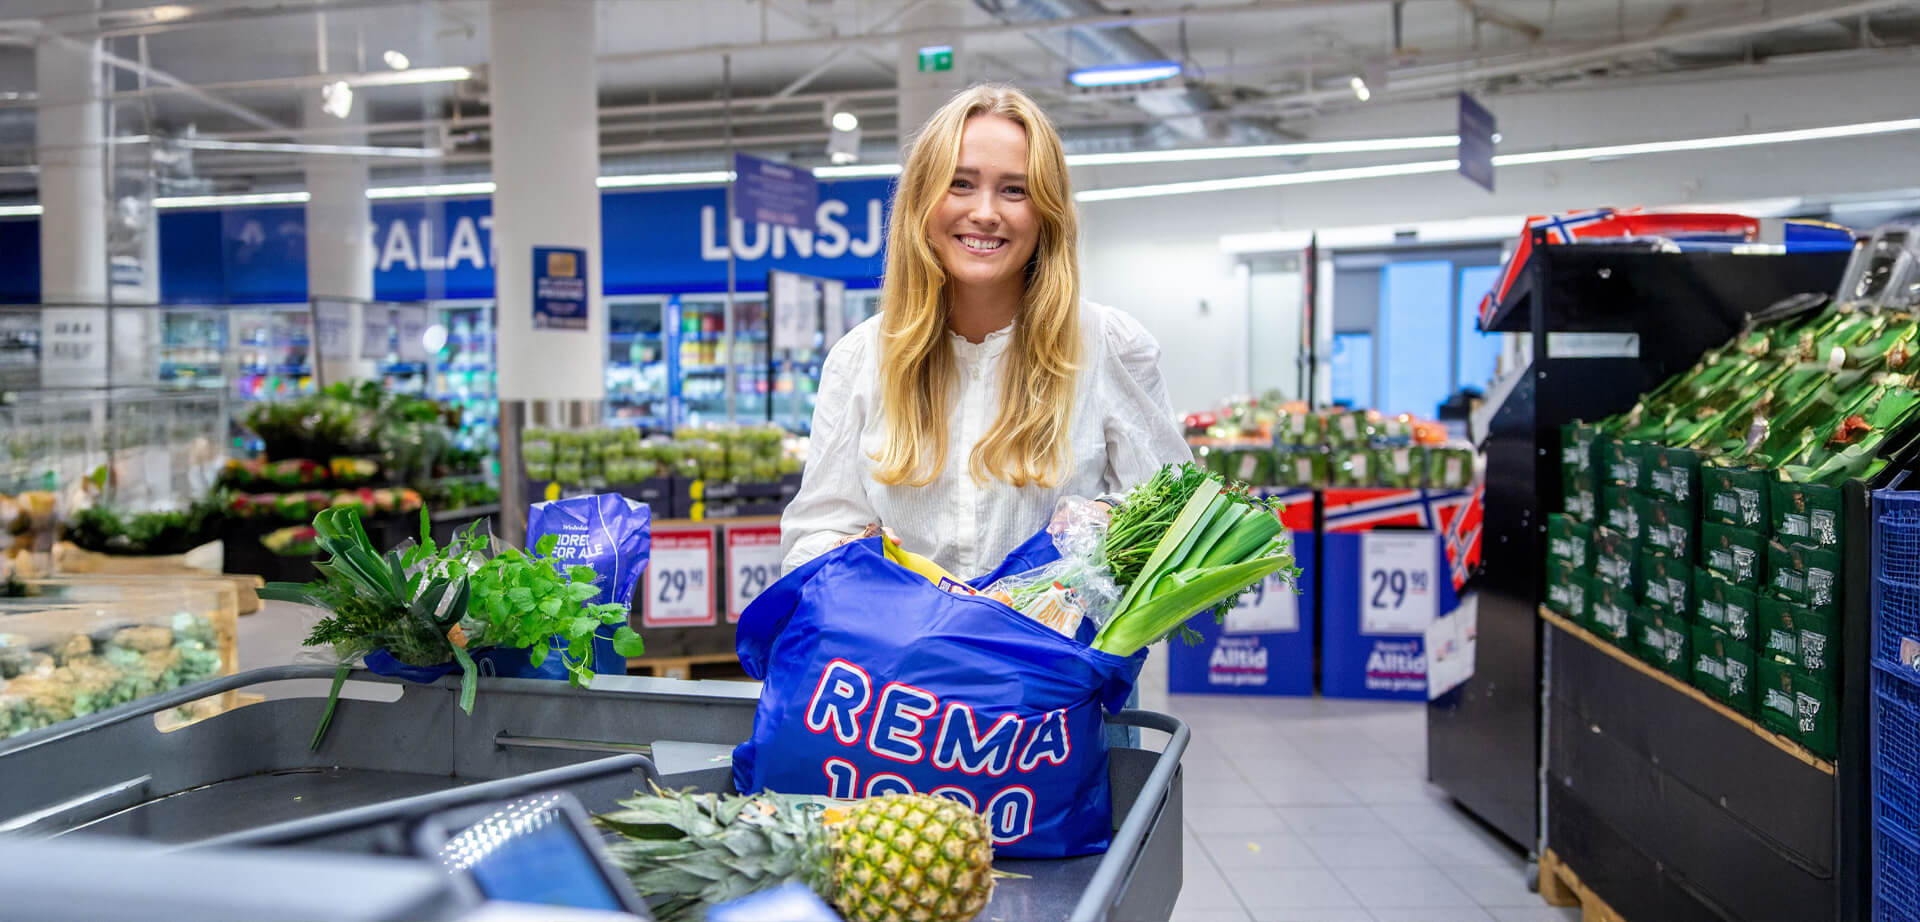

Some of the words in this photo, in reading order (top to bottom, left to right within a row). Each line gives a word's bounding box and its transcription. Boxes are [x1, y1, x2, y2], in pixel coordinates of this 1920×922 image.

[702, 199, 882, 261] LUNSJ
[658, 568, 687, 604] 29
[739, 564, 768, 599] 29
[1371, 568, 1408, 610] 29
[1209, 646, 1269, 669] Alltid
[1366, 651, 1428, 674] Alltid
[804, 657, 1071, 777] REMA
